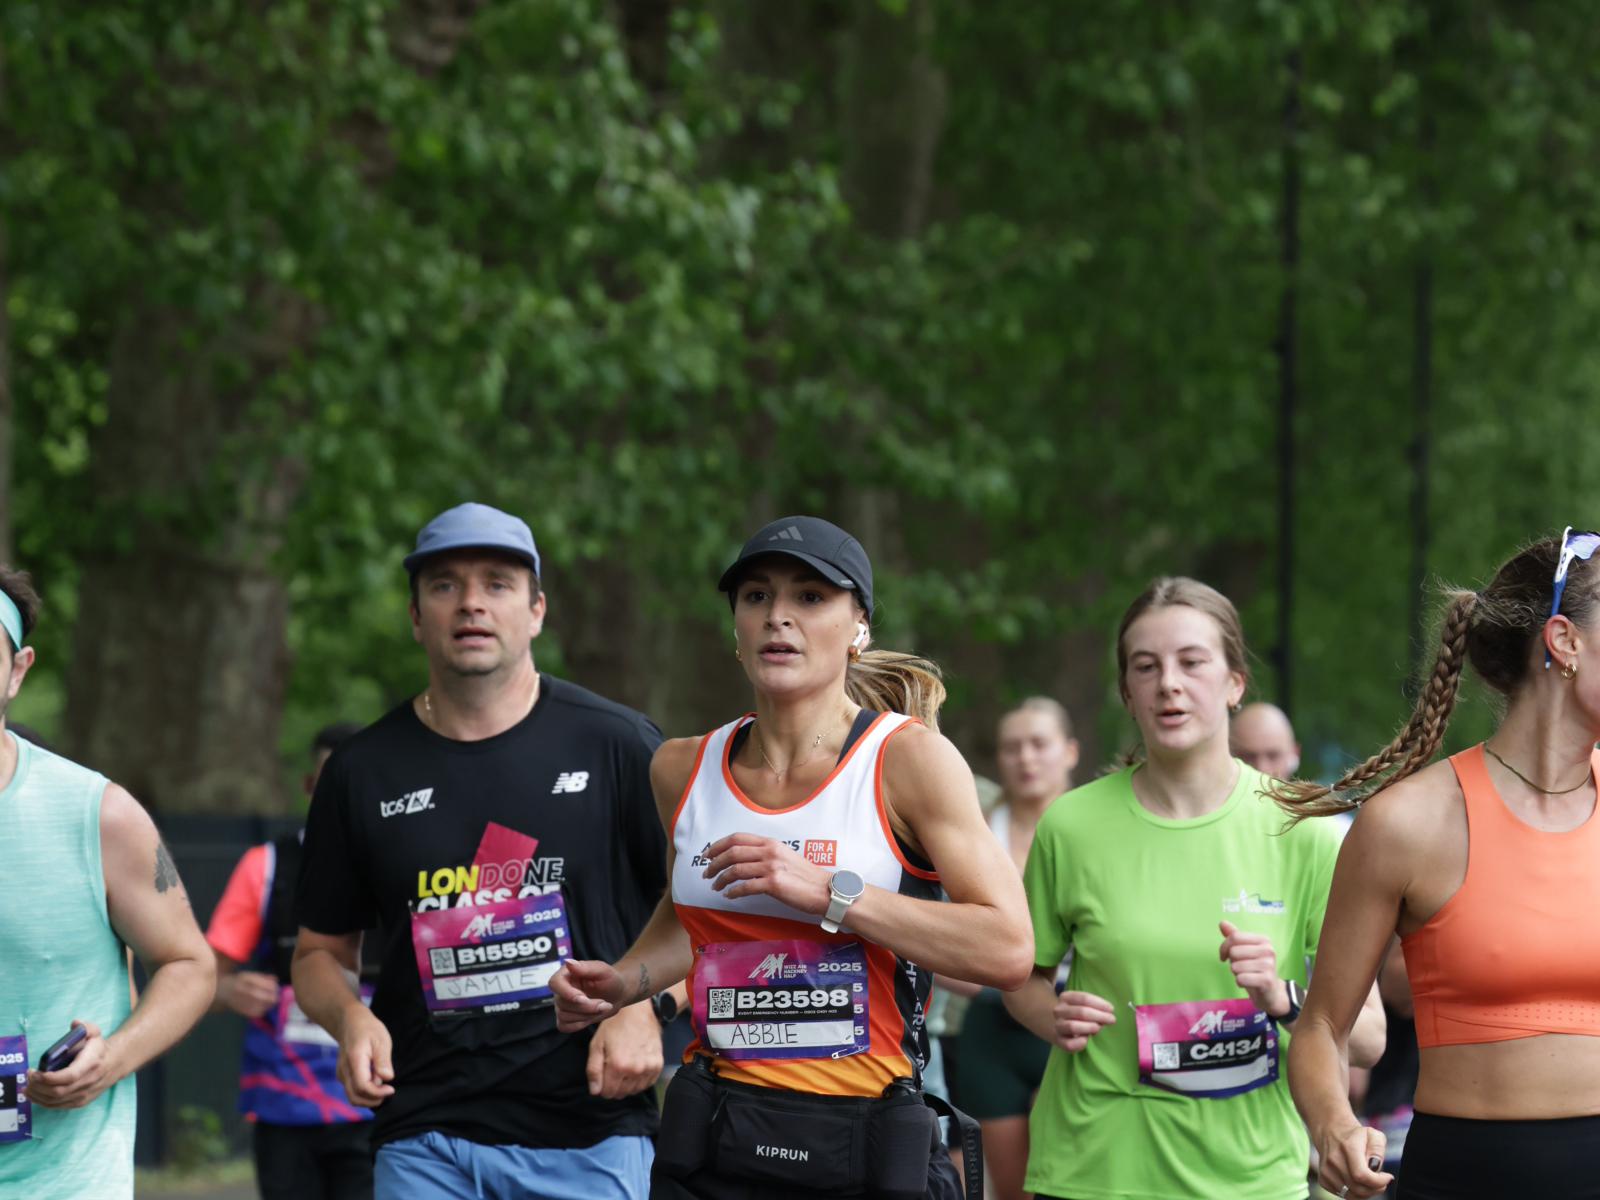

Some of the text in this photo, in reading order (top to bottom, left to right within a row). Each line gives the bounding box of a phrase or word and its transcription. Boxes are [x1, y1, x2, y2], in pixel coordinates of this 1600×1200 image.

[807, 841, 823, 852] FOR
[827, 842, 834, 851] A
[806, 852, 834, 864] CURE
[523, 909, 562, 924] 2025
[554, 927, 565, 938] 5
[457, 936, 552, 966] B15590
[557, 946, 568, 956] 5
[818, 962, 863, 972] 2025
[446, 968, 541, 996] JAMIE
[853, 983, 863, 992] 5
[737, 989, 849, 1009] B23598
[854, 1004, 864, 1014] 5
[731, 1023, 798, 1045] ABBIE
[854, 1026, 865, 1036] 5
[16, 1073, 26, 1084] 5
[18, 1114, 27, 1124] 5
[756, 1144, 808, 1162] KIPRUN
